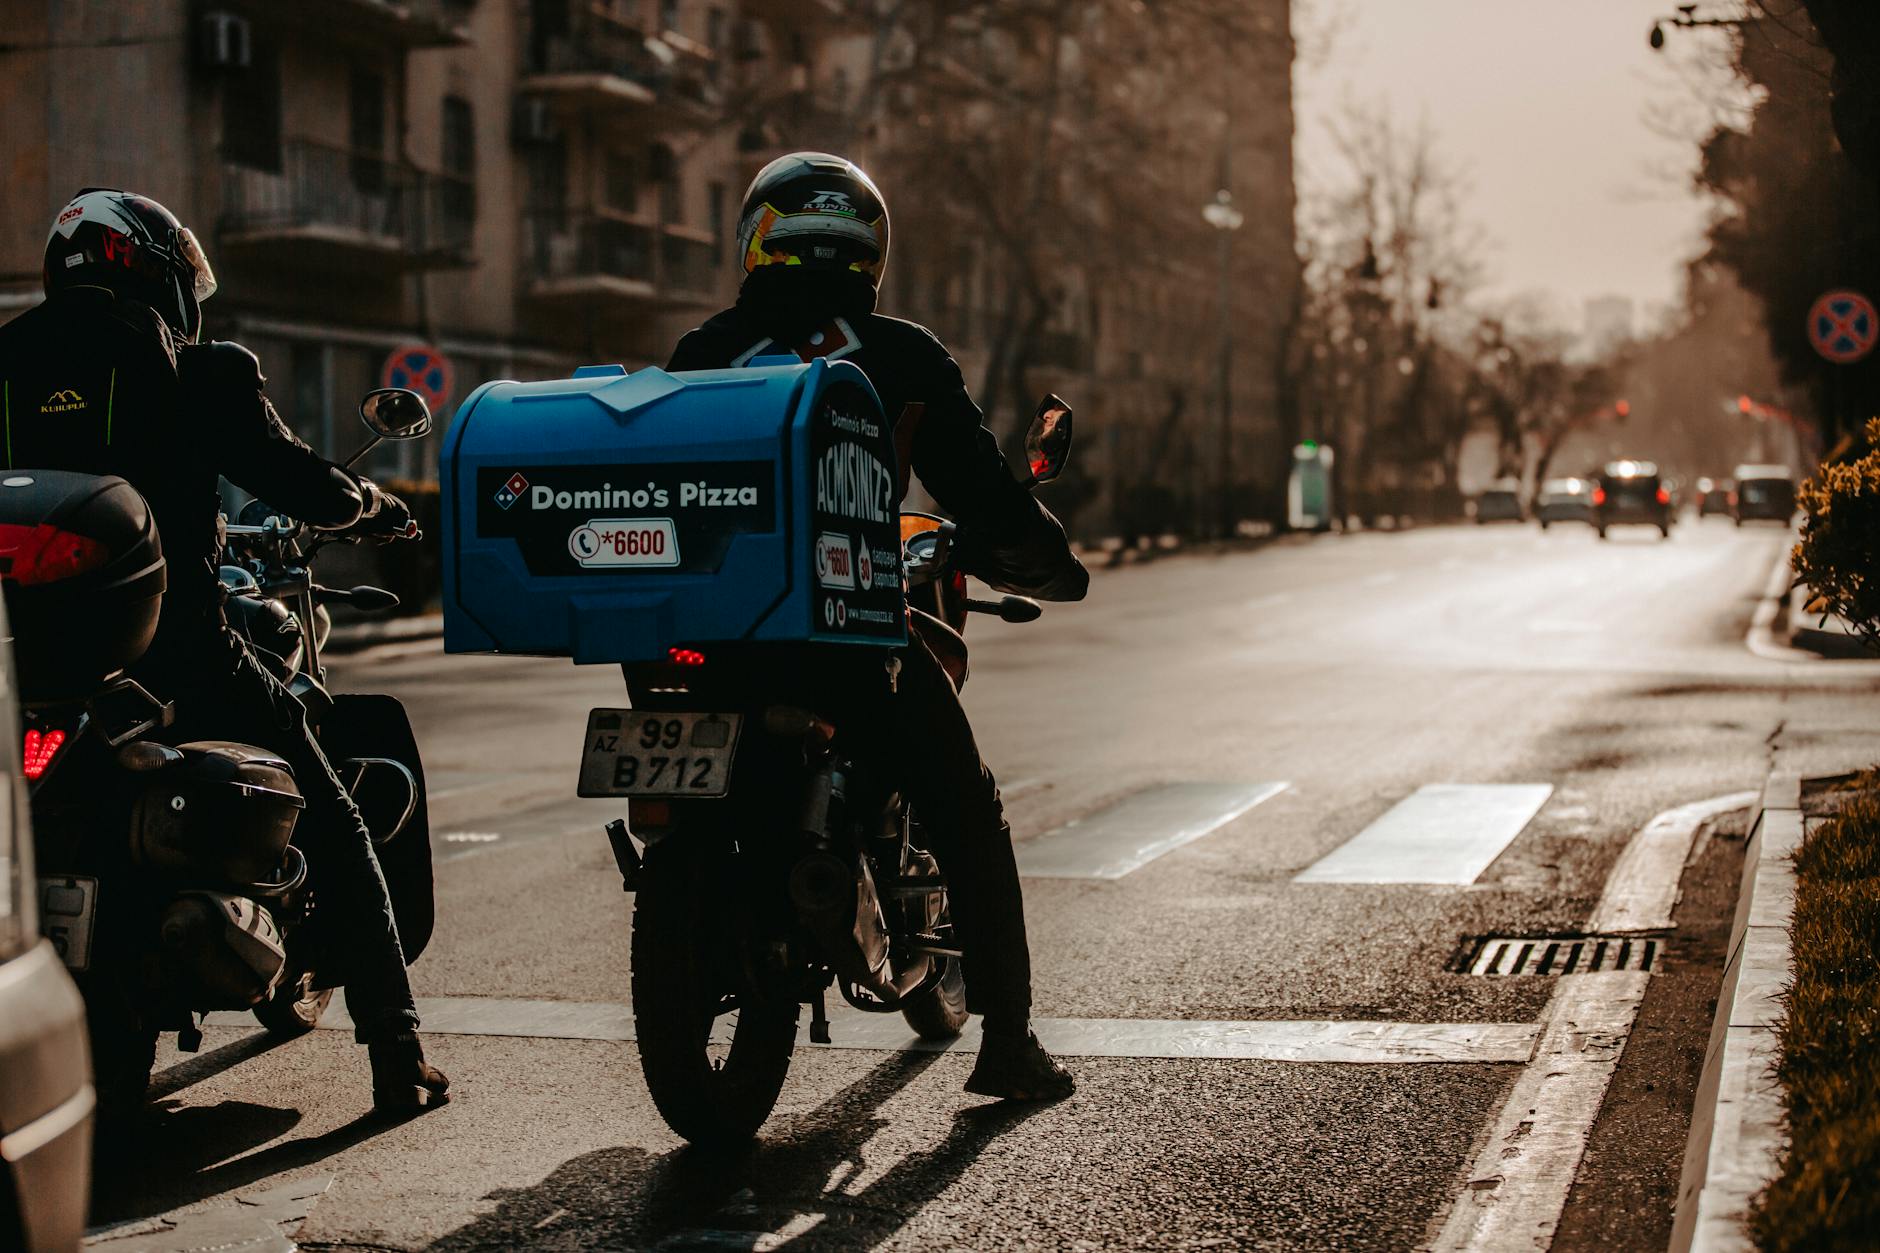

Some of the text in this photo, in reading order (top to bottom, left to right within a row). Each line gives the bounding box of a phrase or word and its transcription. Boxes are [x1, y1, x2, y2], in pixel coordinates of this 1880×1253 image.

[860, 417, 879, 438] Pizza
[531, 481, 758, 510] Domino's Pizza
[861, 557, 870, 581] 30
[593, 735, 620, 752] AZ
[640, 718, 683, 749] 99
[612, 755, 713, 788] B 712
